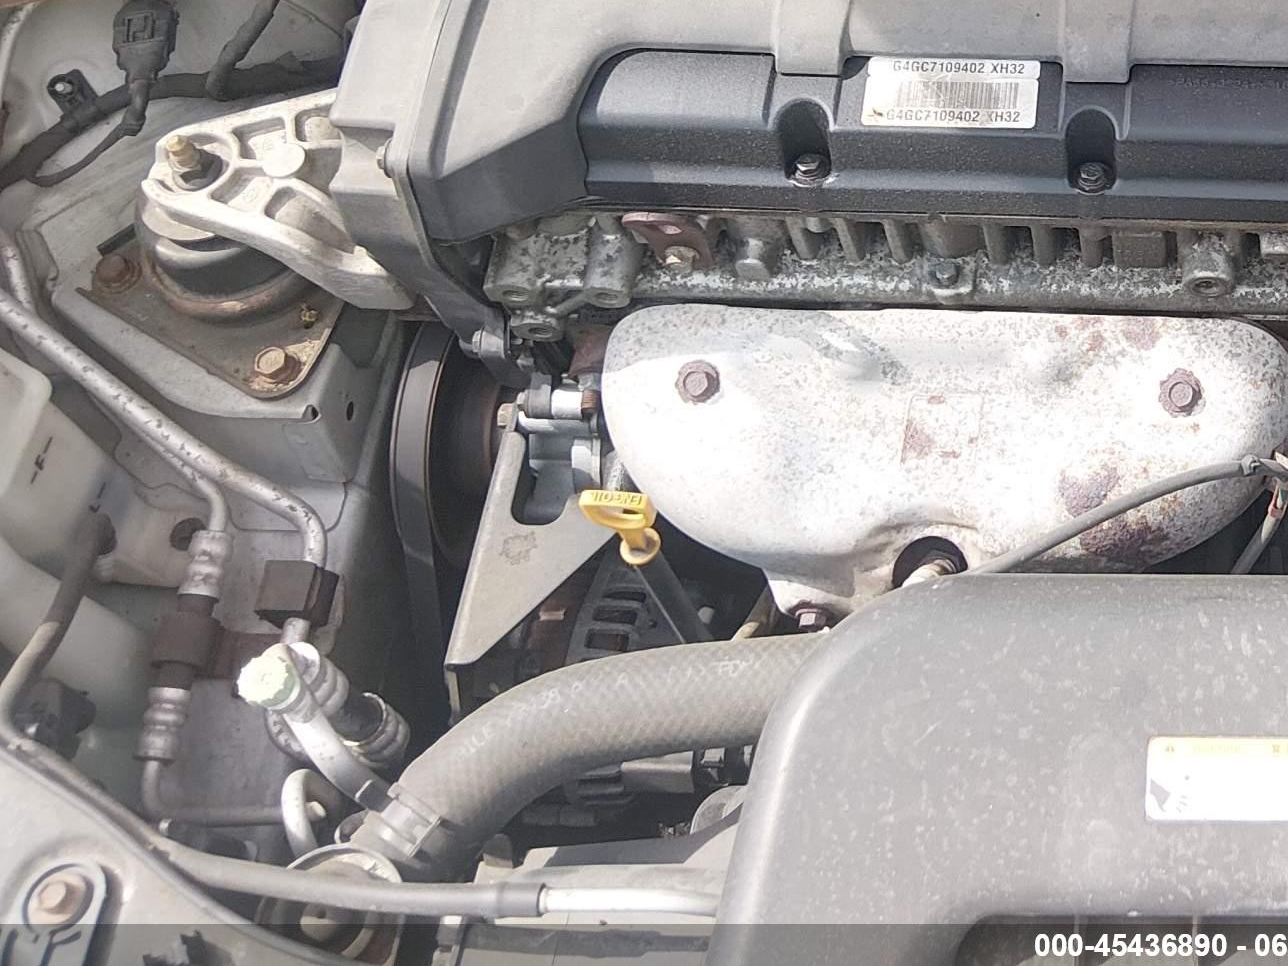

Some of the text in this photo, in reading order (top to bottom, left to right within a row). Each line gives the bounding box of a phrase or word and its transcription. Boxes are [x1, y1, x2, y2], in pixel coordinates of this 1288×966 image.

[893, 61, 1025, 75] G4GC7109402 XH32
[886, 109, 980, 123] G4GC7109402
